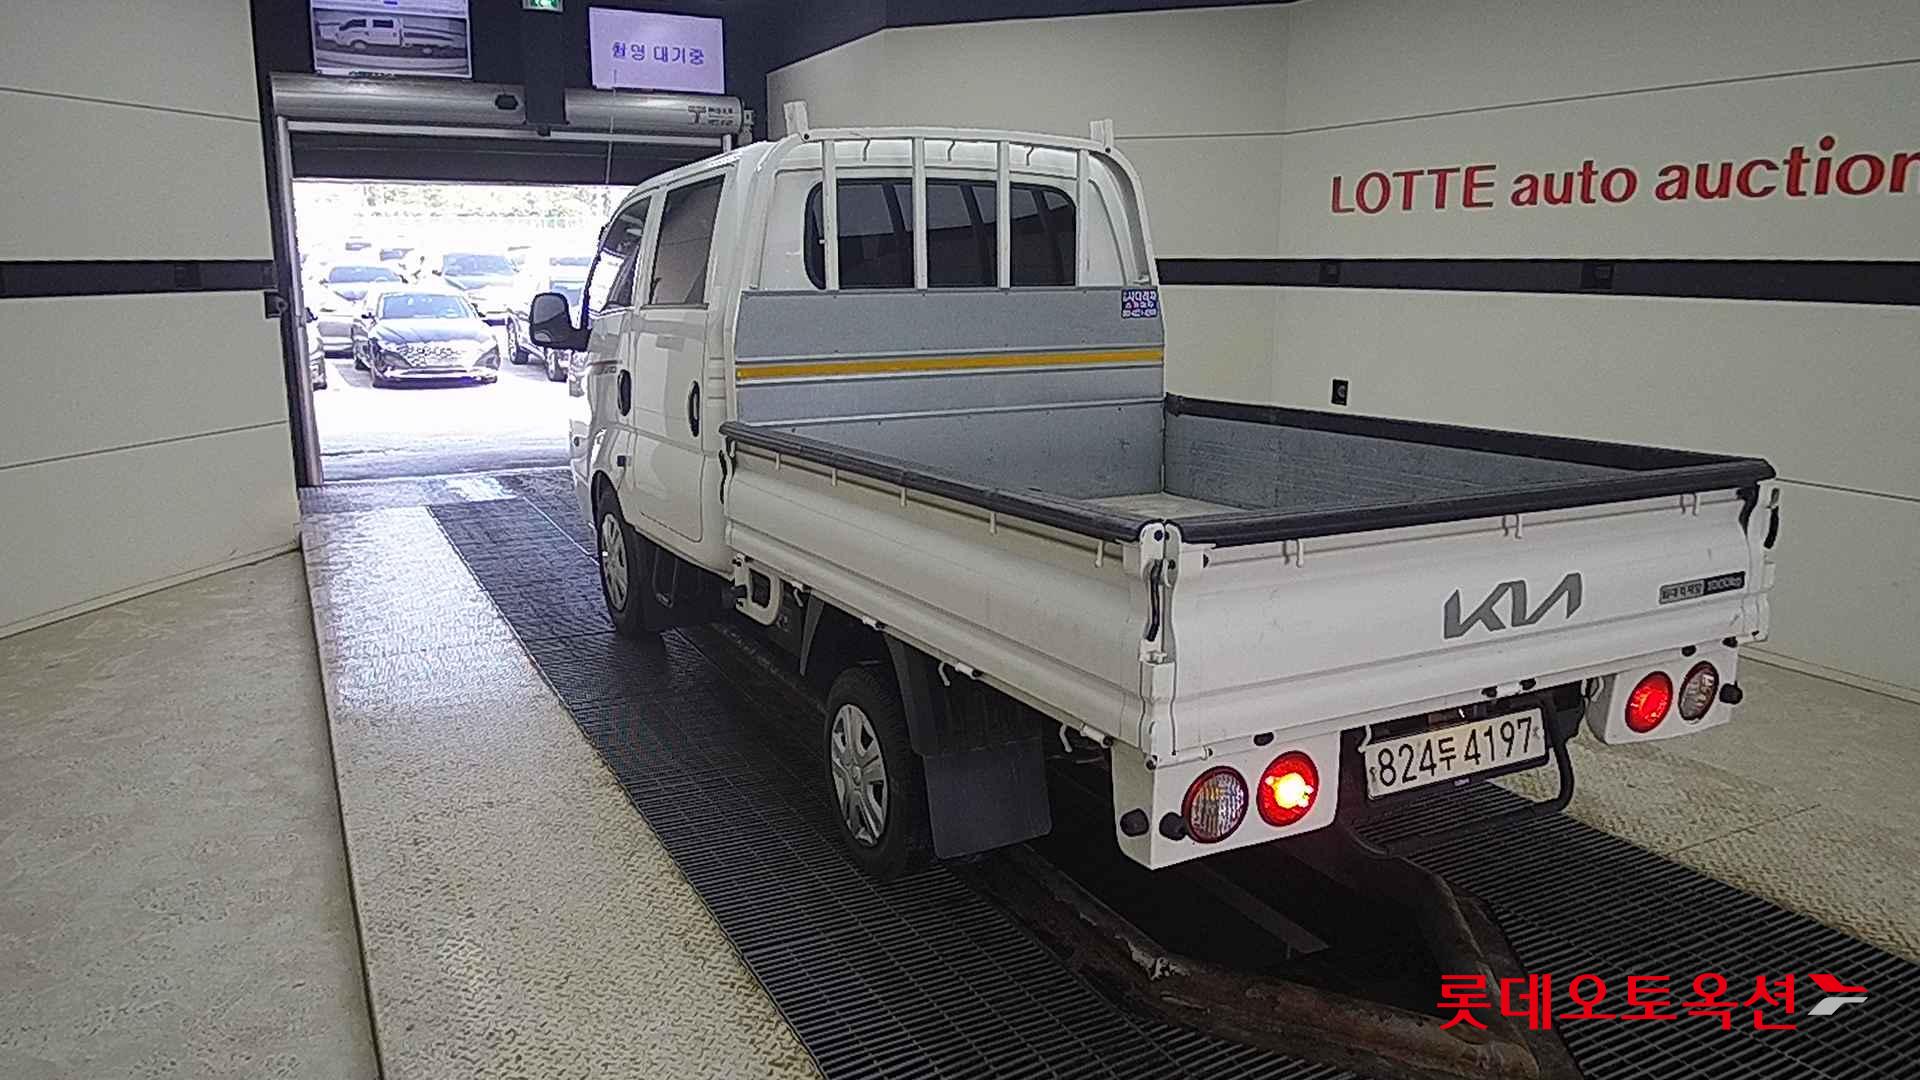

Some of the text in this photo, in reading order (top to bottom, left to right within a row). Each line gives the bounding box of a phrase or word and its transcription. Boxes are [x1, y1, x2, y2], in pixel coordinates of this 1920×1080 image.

[653, 45, 705, 66] 대기중
[1331, 163, 1498, 214] LOTTE
[1510, 159, 1639, 208] auto
